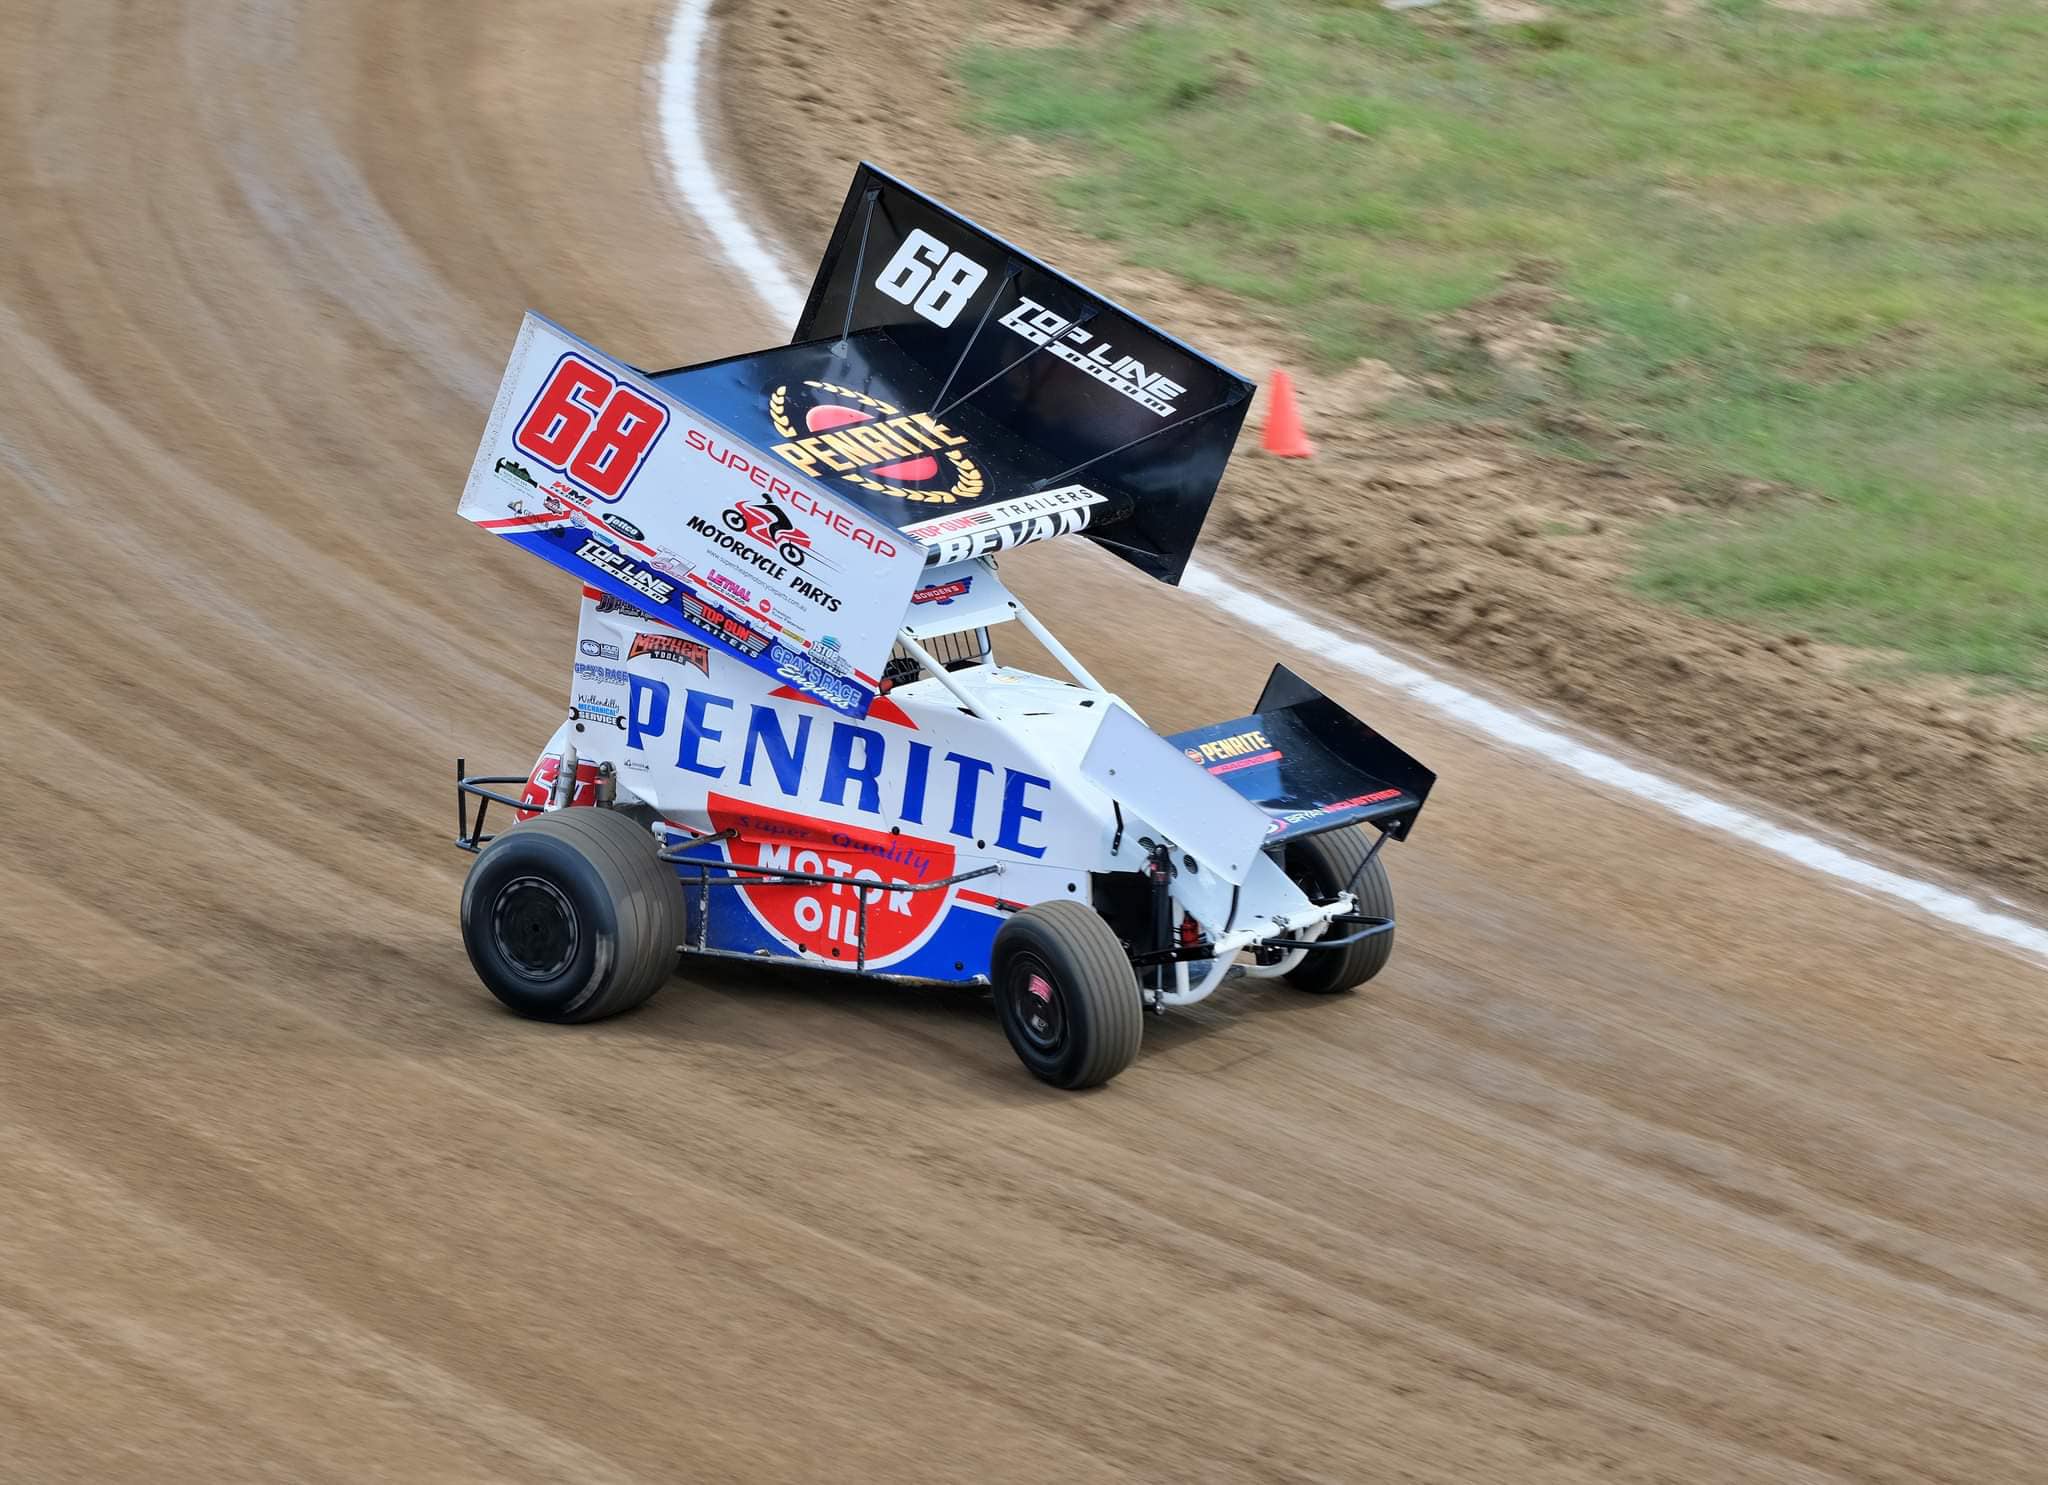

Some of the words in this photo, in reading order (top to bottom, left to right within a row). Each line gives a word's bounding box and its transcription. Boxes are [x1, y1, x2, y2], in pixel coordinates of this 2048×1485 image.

[875, 228, 988, 328] 68
[1000, 296, 1094, 346] TOP
[1087, 342, 1188, 401] LINE
[516, 357, 667, 499] 68
[769, 413, 969, 478] PENRITE
[685, 429, 897, 558] SUPERCHEAP
[914, 526, 941, 540] TOP
[941, 517, 977, 533] GUN
[996, 489, 1094, 518] TRAILERS
[577, 539, 625, 563] TOP
[622, 563, 676, 596] LINE
[686, 515, 787, 581] MOTORCYCLE
[789, 576, 843, 613] PARTS
[707, 568, 752, 603] LETHAL
[683, 611, 760, 659] TRAILERS
[701, 605, 725, 625] TOP
[723, 619, 751, 642] GUN
[770, 645, 821, 684] GRAY'S
[819, 673, 862, 708] RACE
[777, 663, 849, 709] Engines
[578, 703, 618, 717] MECHANICAL
[579, 710, 618, 725] SERVICE
[625, 672, 1053, 859] PENRITE
[1199, 730, 1273, 762] PENRITE
[739, 815, 811, 839] Super
[831, 831, 930, 879] Quality
[758, 842, 913, 917] MOTOR
[793, 896, 862, 947] OIL
